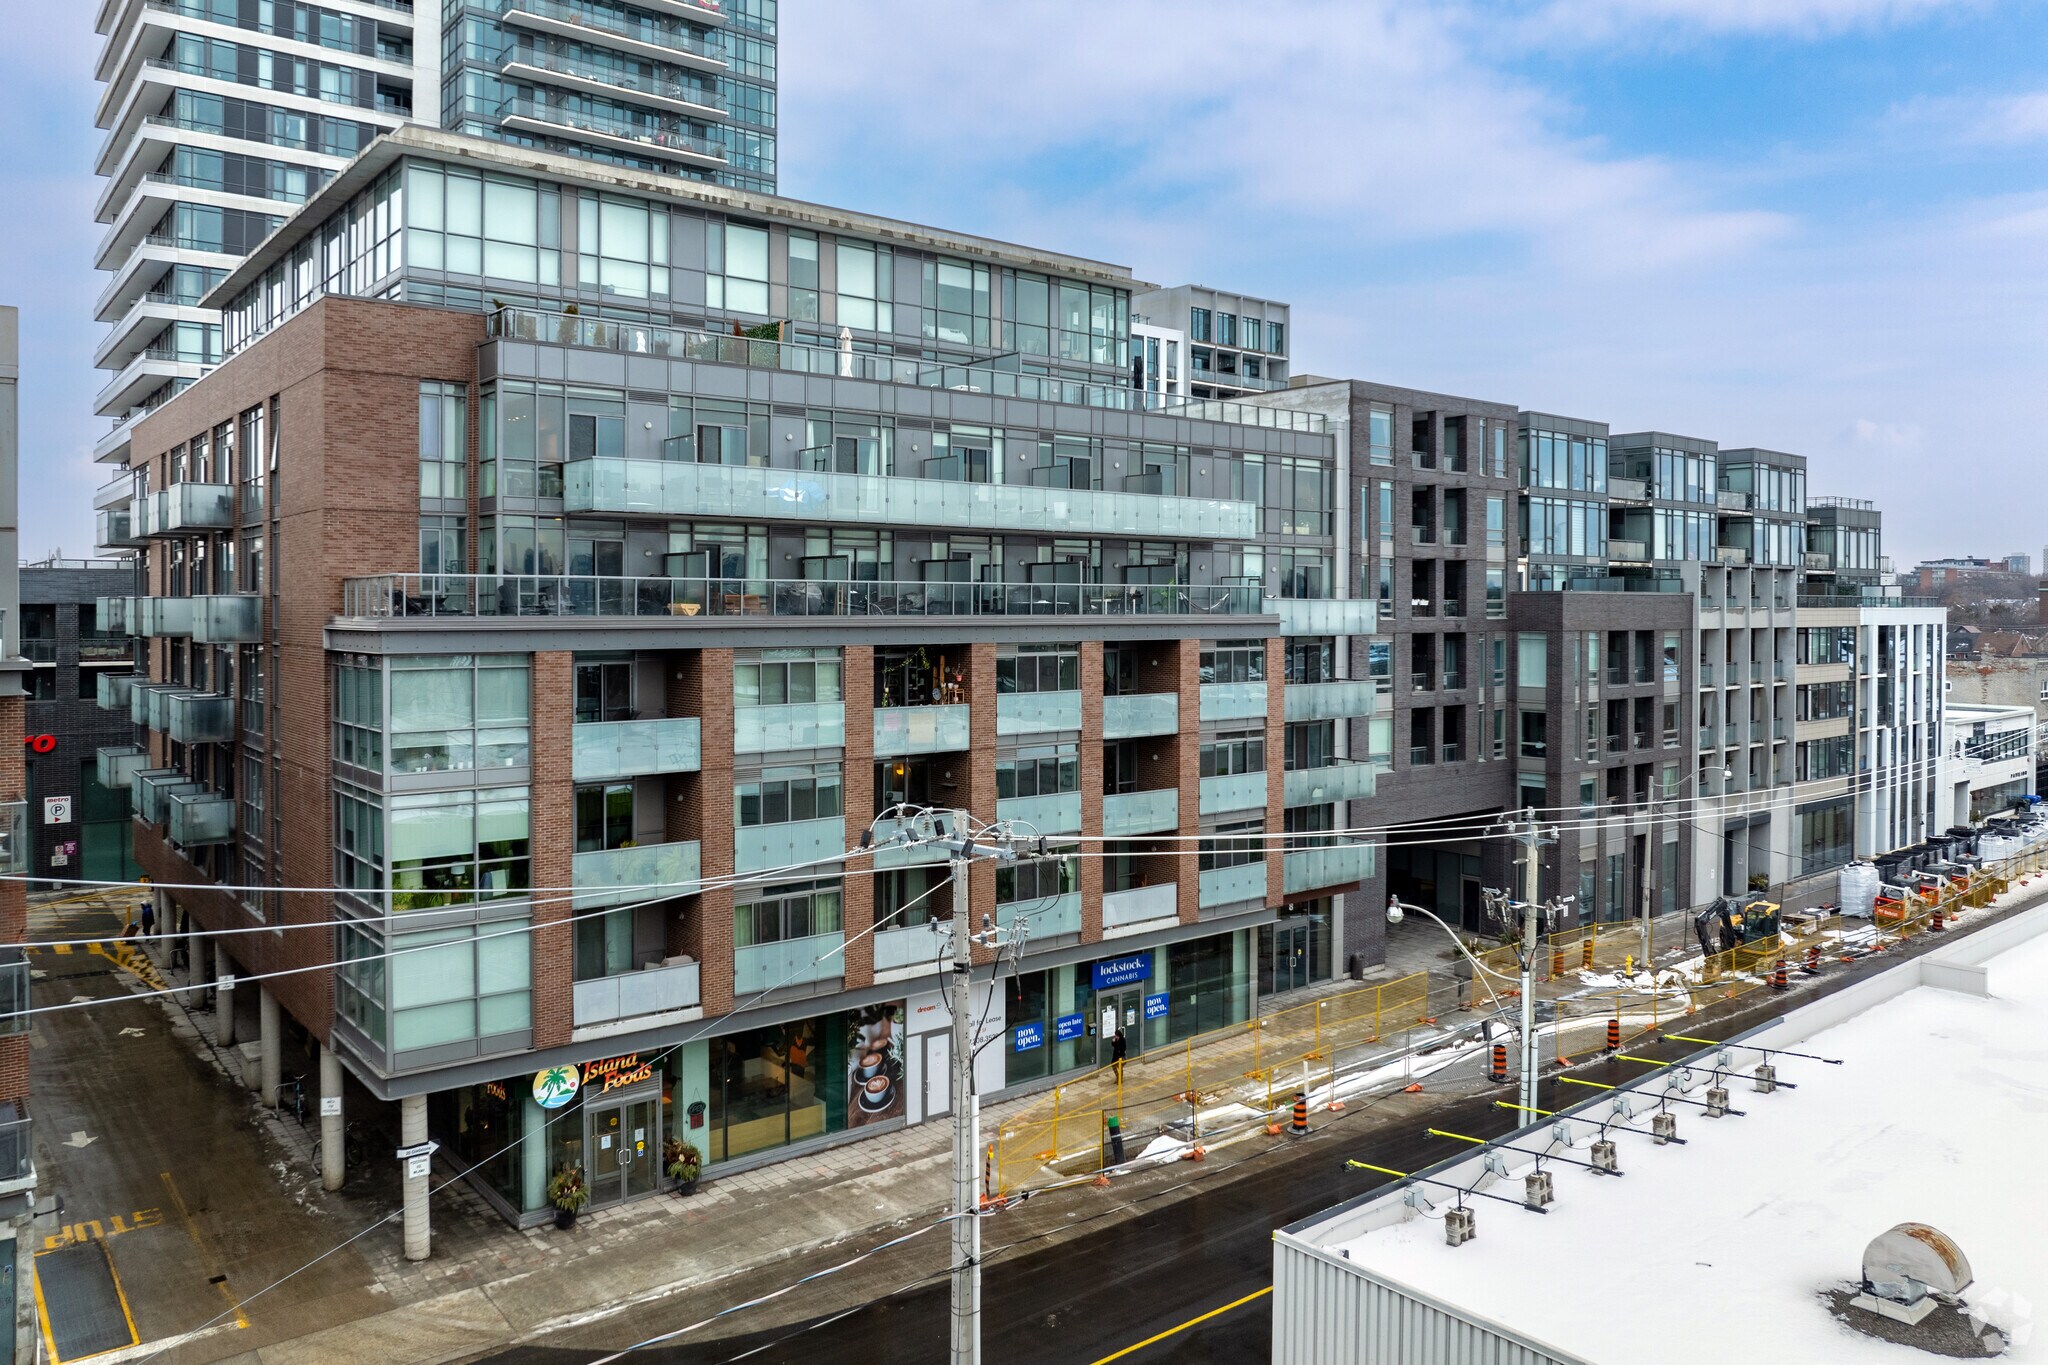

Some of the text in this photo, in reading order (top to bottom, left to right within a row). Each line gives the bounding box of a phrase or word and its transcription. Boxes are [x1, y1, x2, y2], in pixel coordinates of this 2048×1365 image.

[1100, 958, 1144, 976] lockstock.
[1106, 972, 1138, 984] CANNABIS
[1147, 997, 1162, 1007] now
[917, 1005, 936, 1013] dream
[1147, 1004, 1167, 1016] open.
[986, 1016, 1001, 1024] Lease
[1018, 1027, 1035, 1038] now
[1017, 1035, 1040, 1047] open.
[581, 1052, 638, 1086] Island
[602, 1062, 652, 1093] Foods
